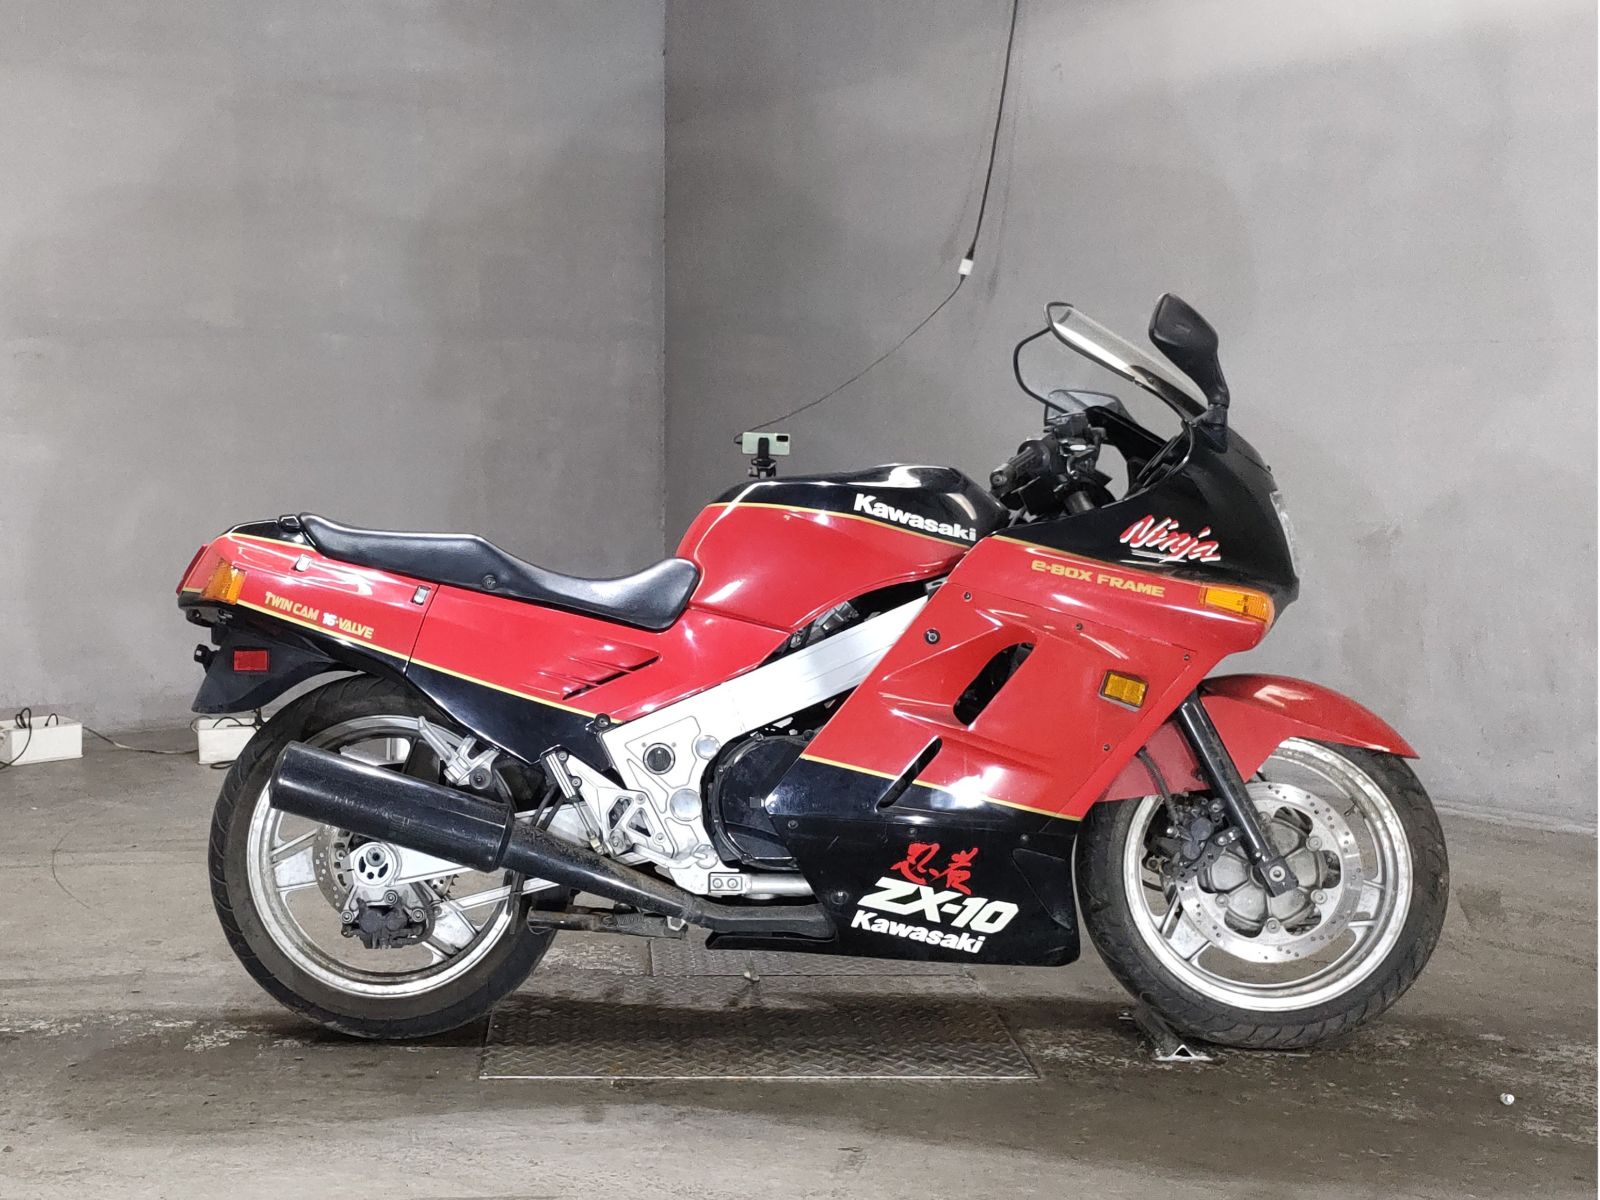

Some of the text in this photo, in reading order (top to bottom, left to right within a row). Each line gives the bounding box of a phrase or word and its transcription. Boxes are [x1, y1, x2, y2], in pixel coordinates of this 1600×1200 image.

[853, 493, 976, 541] Kawasaki
[1120, 514, 1221, 563] Ninja
[265, 591, 293, 612] TWIN
[292, 603, 320, 621] CAM
[1097, 574, 1165, 597] FRAME
[857, 876, 1019, 934] ZX-10
[850, 909, 986, 954] Kawasaki
